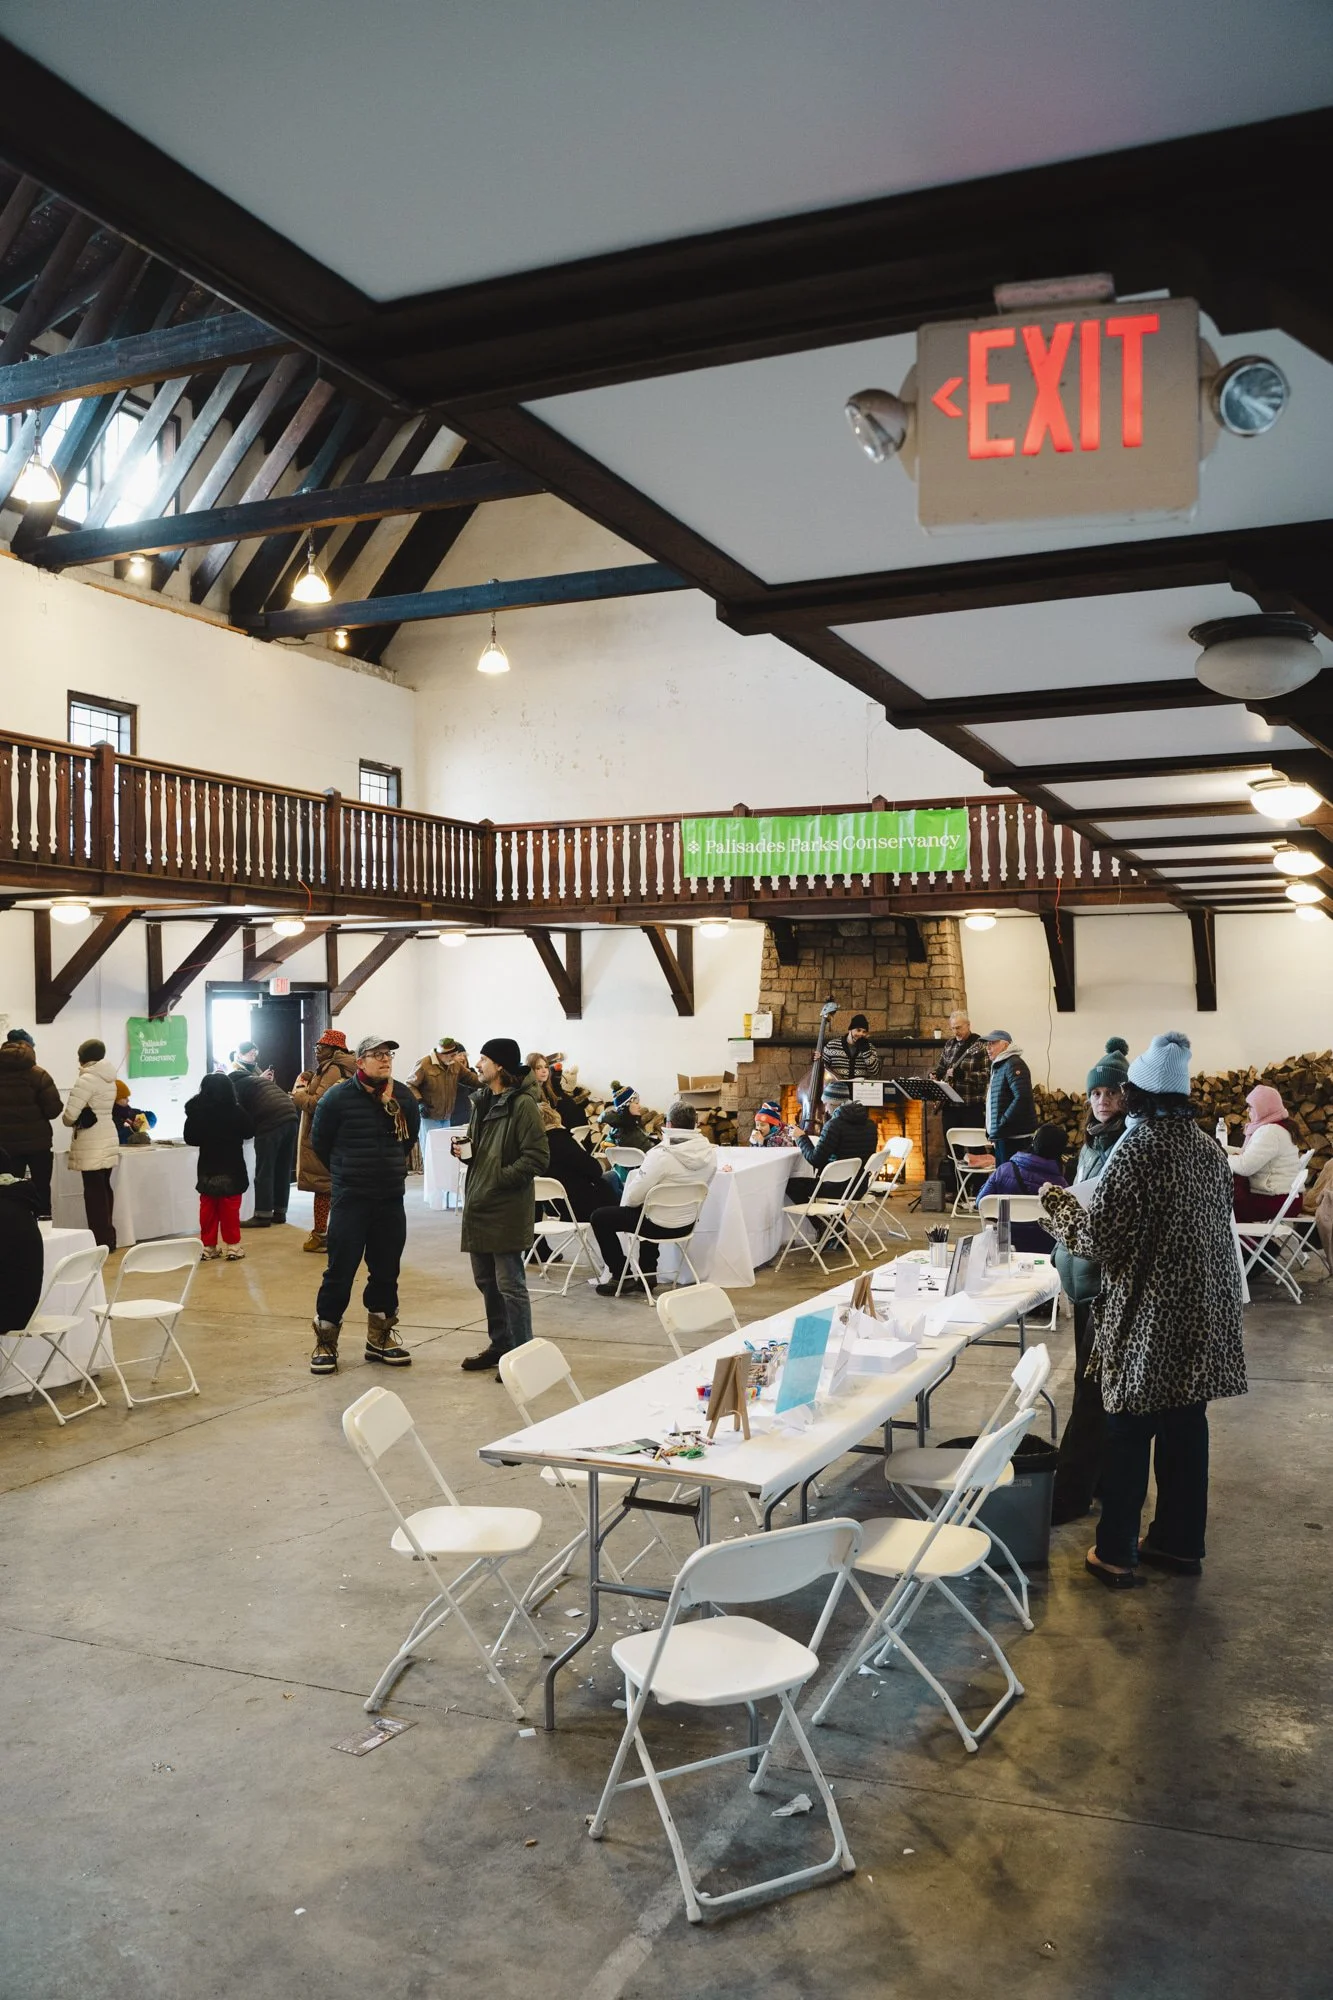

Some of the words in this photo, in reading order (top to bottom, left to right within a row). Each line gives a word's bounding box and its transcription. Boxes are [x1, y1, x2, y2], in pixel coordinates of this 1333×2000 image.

[969, 315, 1158, 459] EXIT
[705, 838, 786, 854] Palisades
[789, 836, 840, 853] Parks
[843, 834, 960, 850] Conservancy
